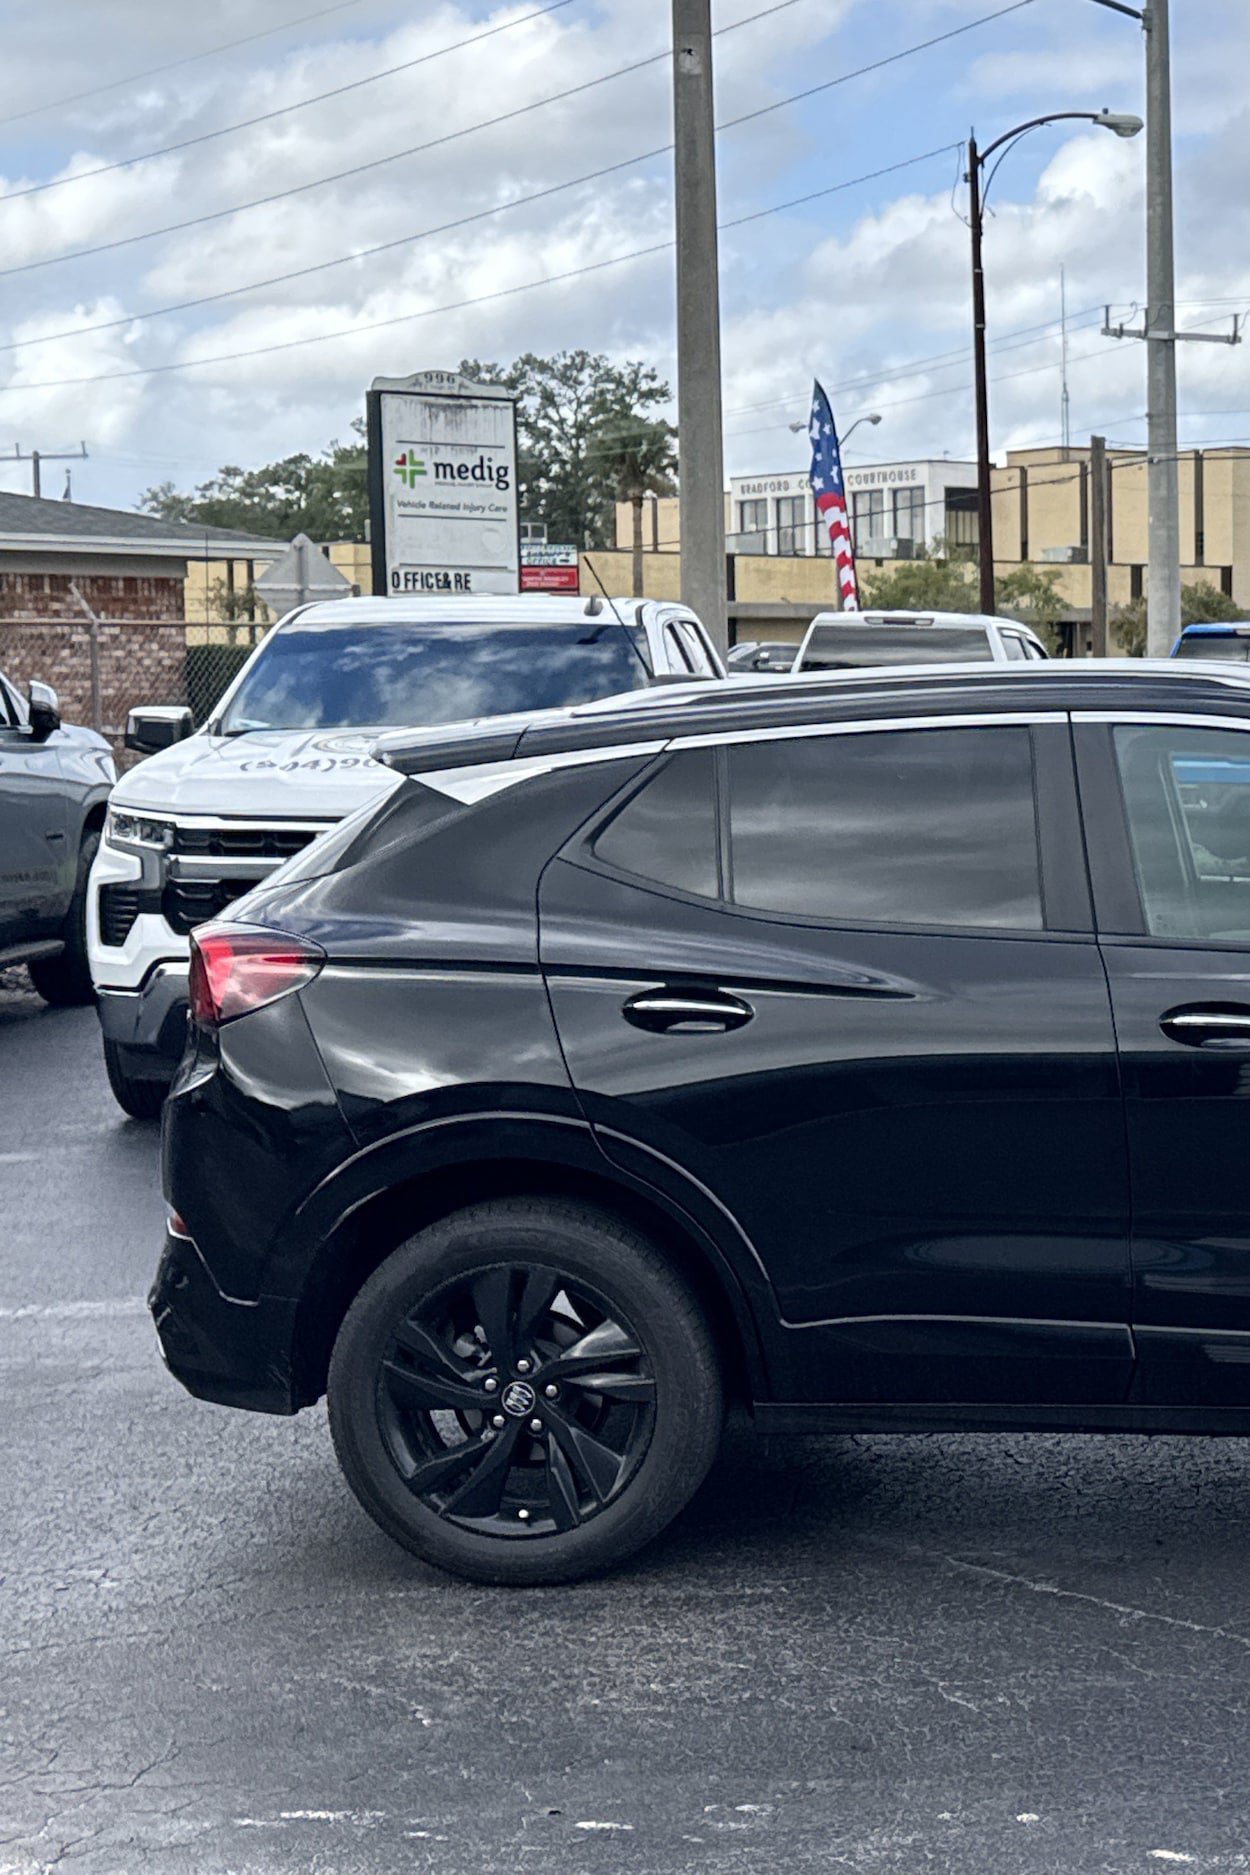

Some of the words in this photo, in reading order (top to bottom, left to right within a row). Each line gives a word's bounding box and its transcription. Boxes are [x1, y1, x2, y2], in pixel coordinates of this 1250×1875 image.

[433, 456, 509, 491] medig
[740, 480, 790, 495] BRADFORD
[847, 469, 917, 486] COURTHOUSE
[397, 500, 426, 509] Vehicle
[429, 501, 460, 510] Related
[463, 503, 485, 513] Injury
[488, 503, 508, 512] Care
